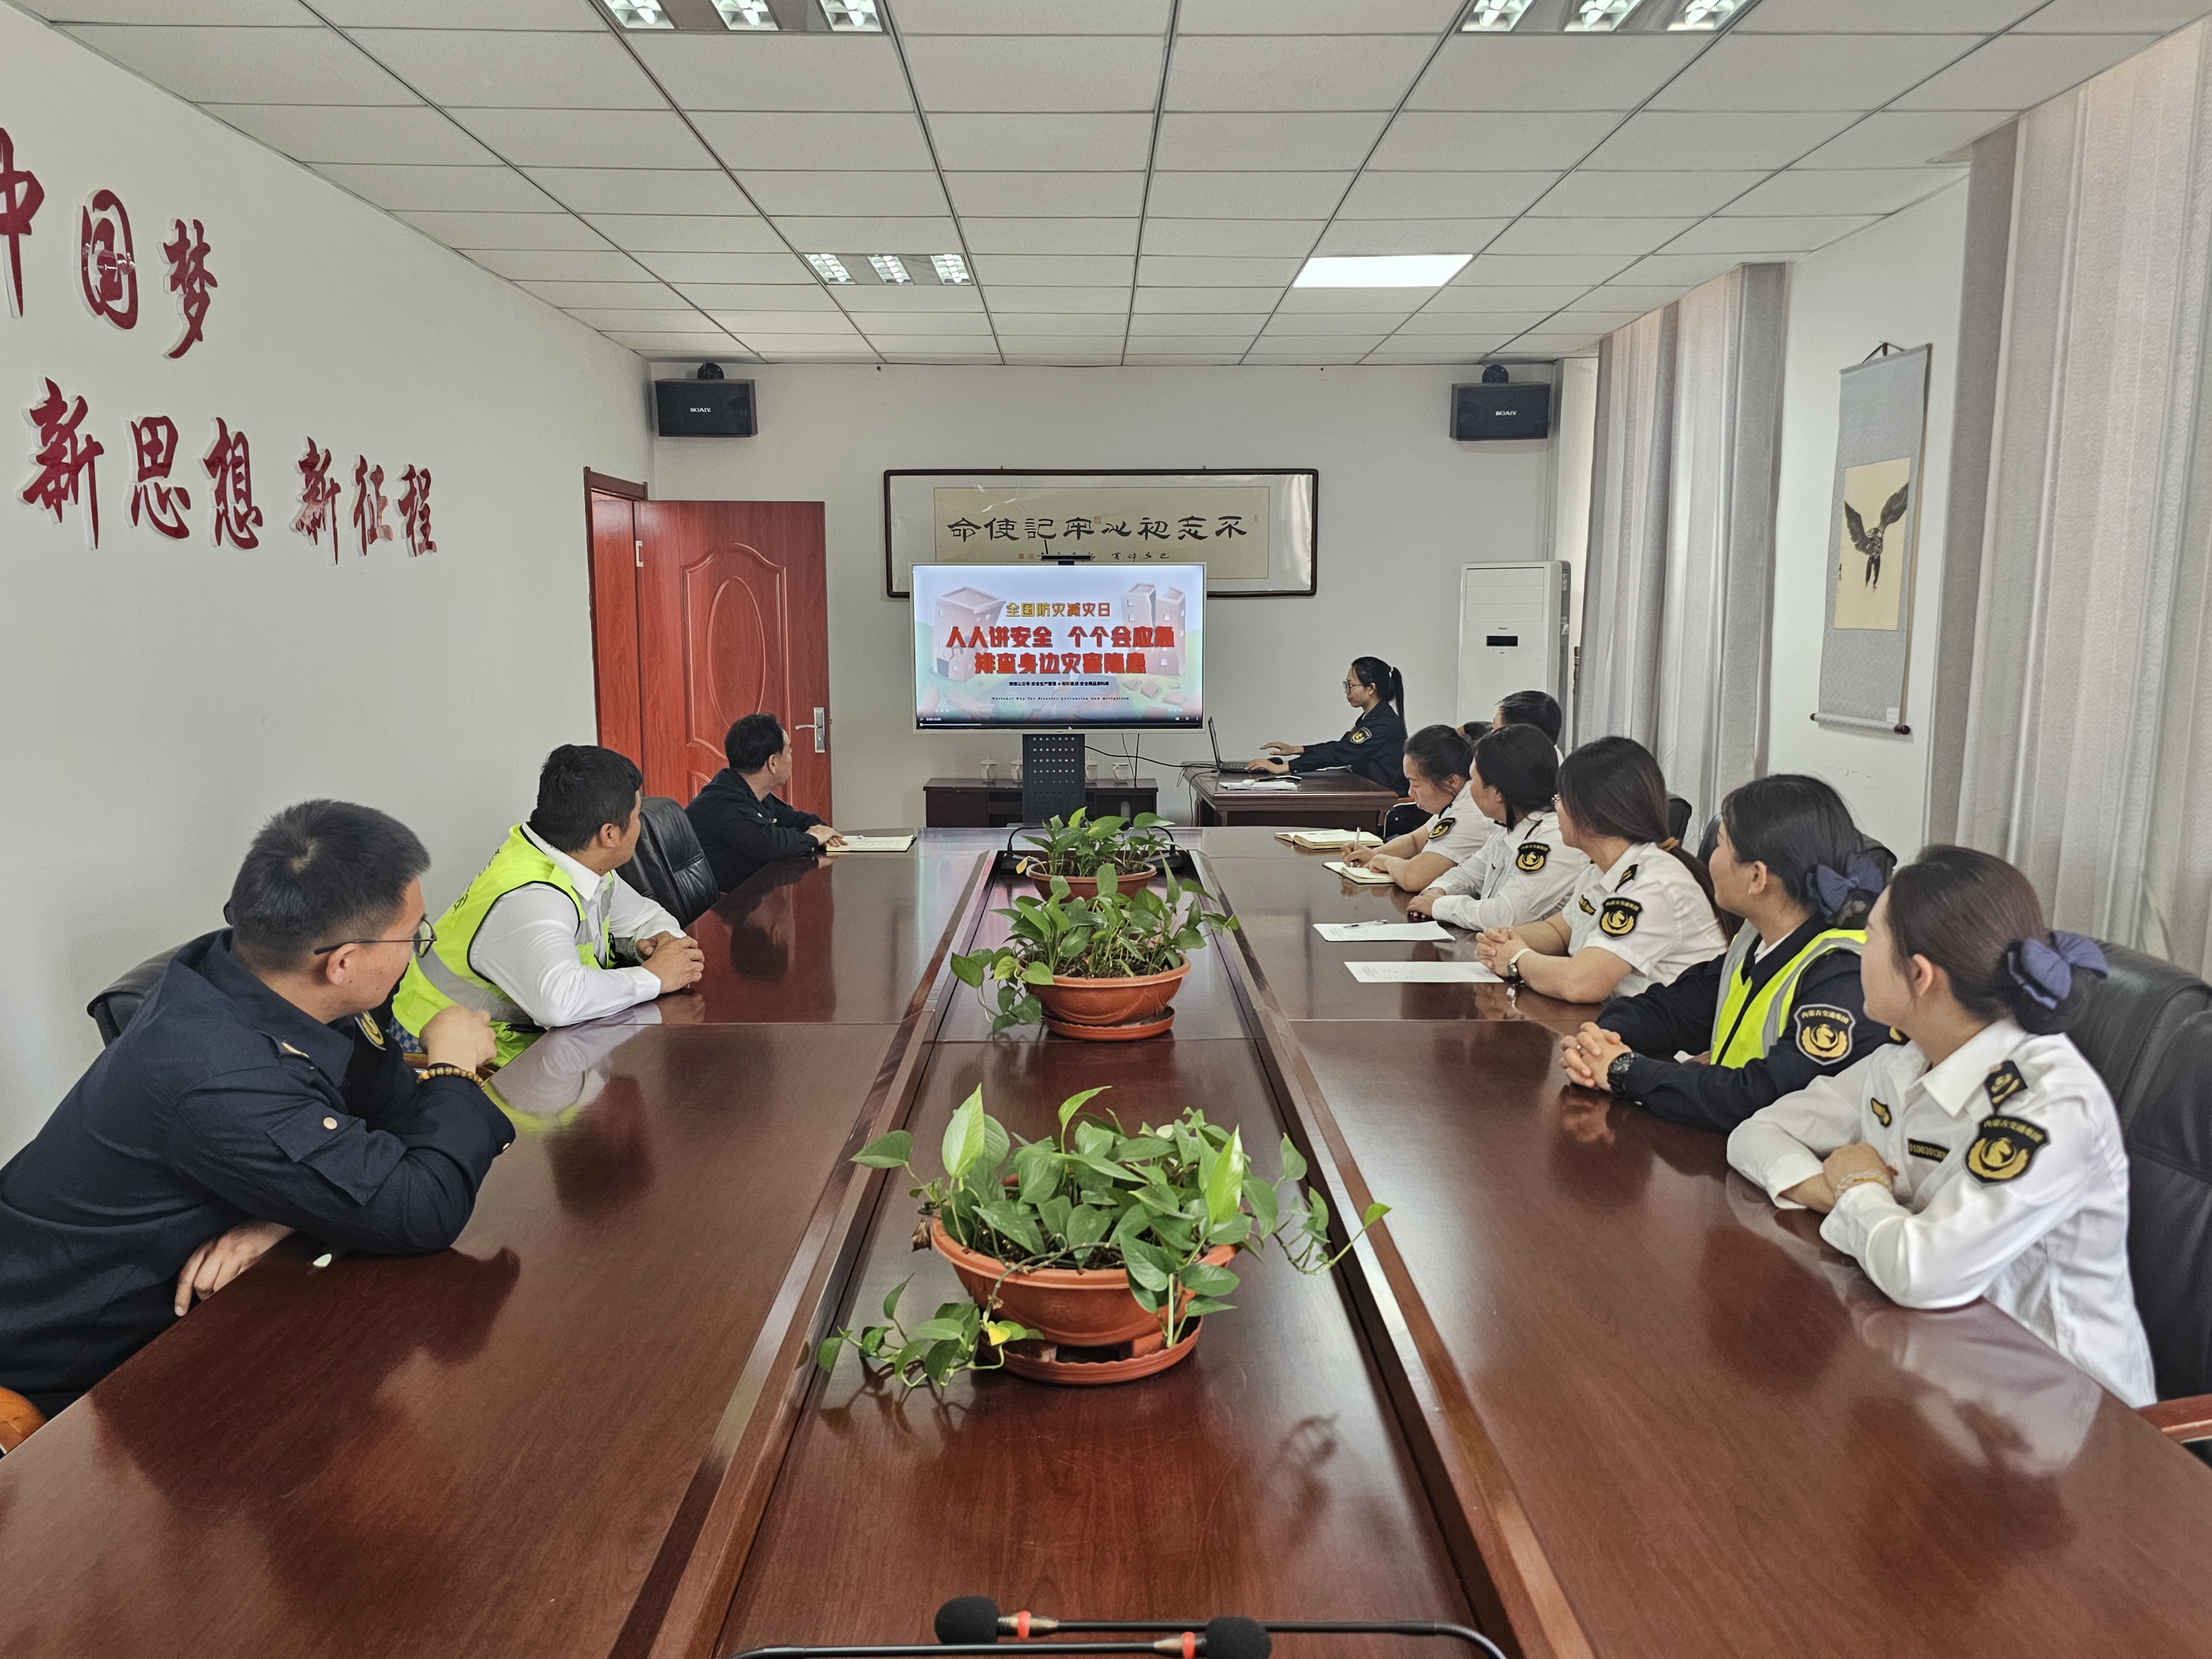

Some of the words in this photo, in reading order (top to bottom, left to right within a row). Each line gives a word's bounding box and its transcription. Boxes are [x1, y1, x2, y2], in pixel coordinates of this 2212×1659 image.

[21, 377, 263, 550] 新思想
[292, 436, 437, 565] 新征程
[1005, 602, 1110, 617] 全国防灾减灾日
[946, 626, 1053, 648] 人人讲安全
[1067, 625, 1175, 648] 个个会应急
[974, 652, 1146, 674] 排查身边灾害隐患
